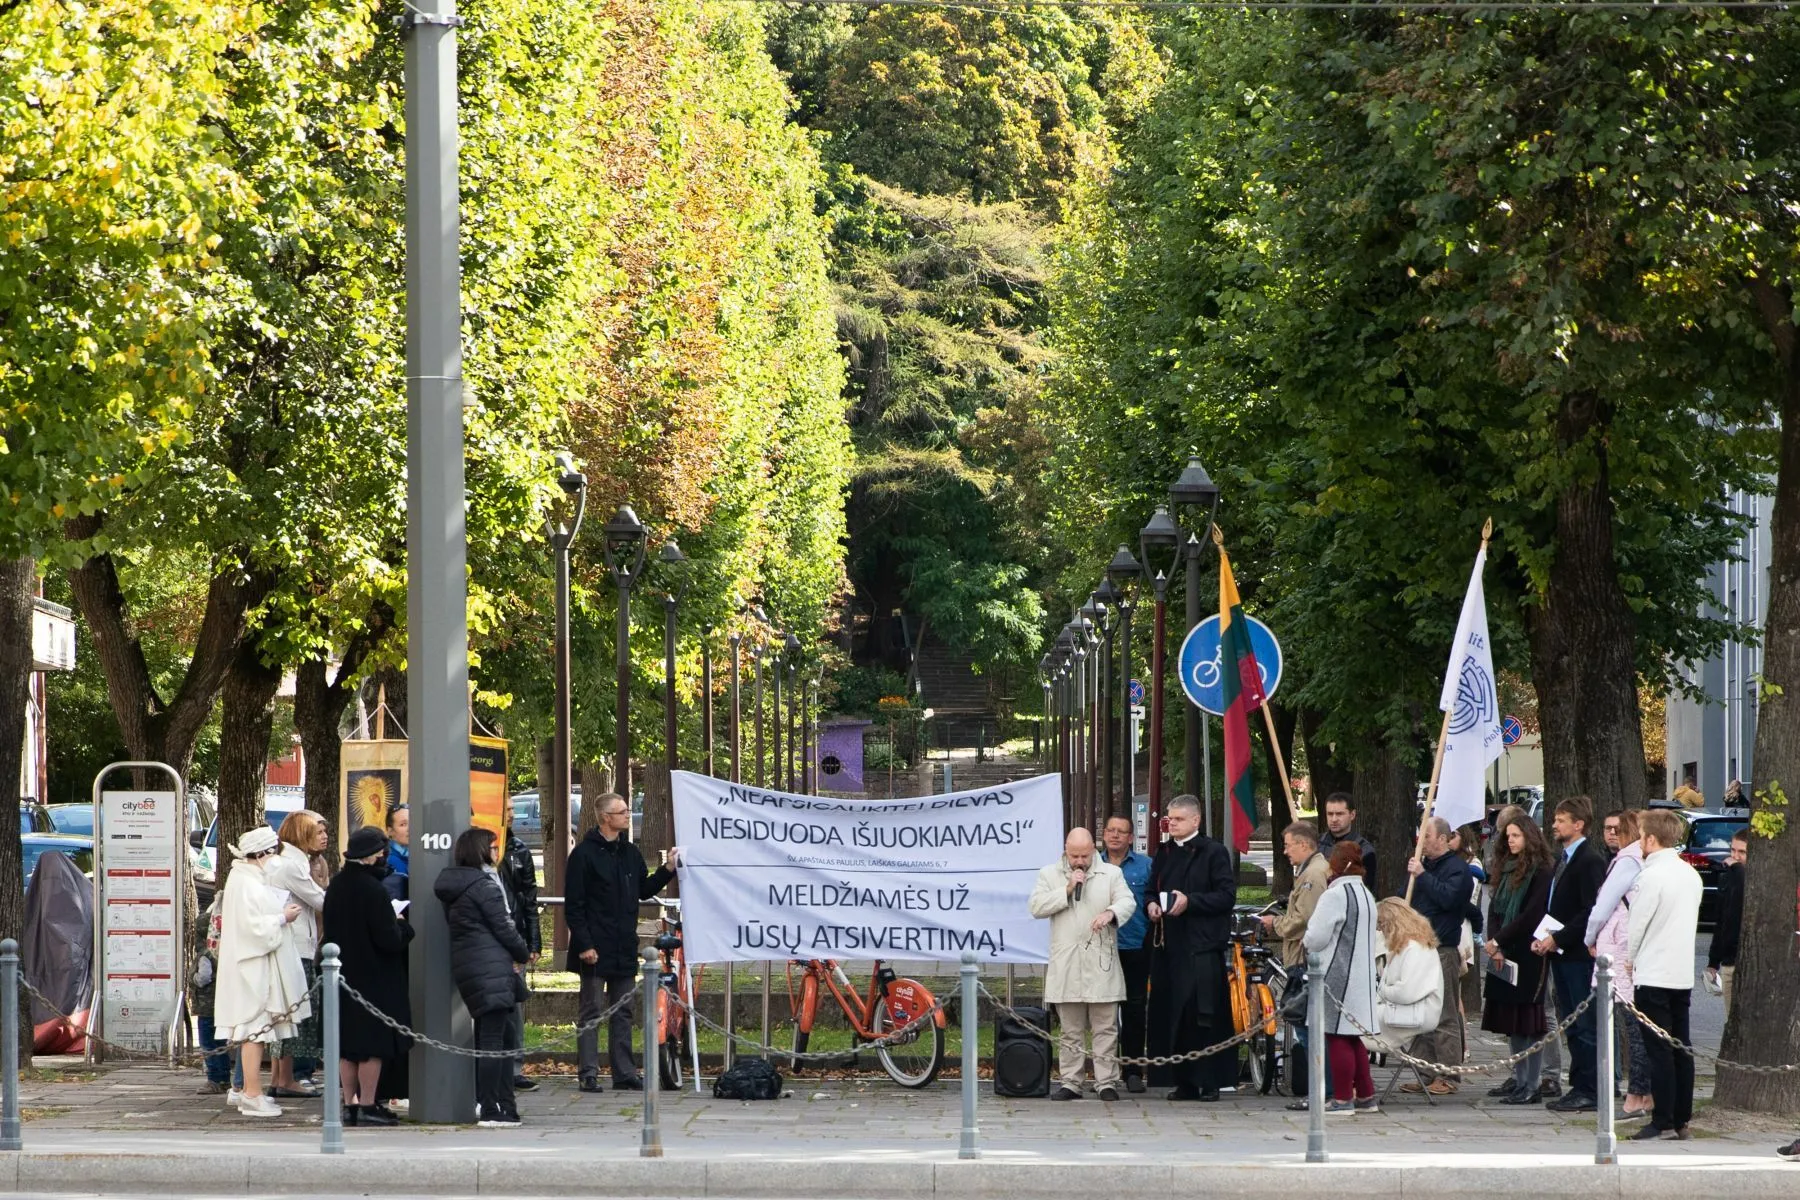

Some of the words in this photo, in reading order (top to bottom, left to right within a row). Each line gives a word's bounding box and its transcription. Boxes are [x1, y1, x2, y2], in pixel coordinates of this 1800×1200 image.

[122, 798, 156, 811] citybee
[931, 790, 1014, 809] DIEVAS
[421, 833, 452, 849] 110
[700, 817, 844, 845] NESIDUODA
[852, 819, 1034, 848] IŠJUOKIAMAS!“
[799, 856, 835, 866] APAŠTALAS
[836, 858, 867, 867] PAULIUS,
[868, 858, 896, 867] LAIŠKAS
[897, 860, 935, 868] GALATAMS
[944, 860, 948, 868] 7
[768, 880, 930, 911] MELDŽIAMĖS
[937, 883, 970, 911] UŽ
[732, 920, 801, 955] JŪSŲ
[811, 925, 1005, 957] ATSIVERTIMĄ!
